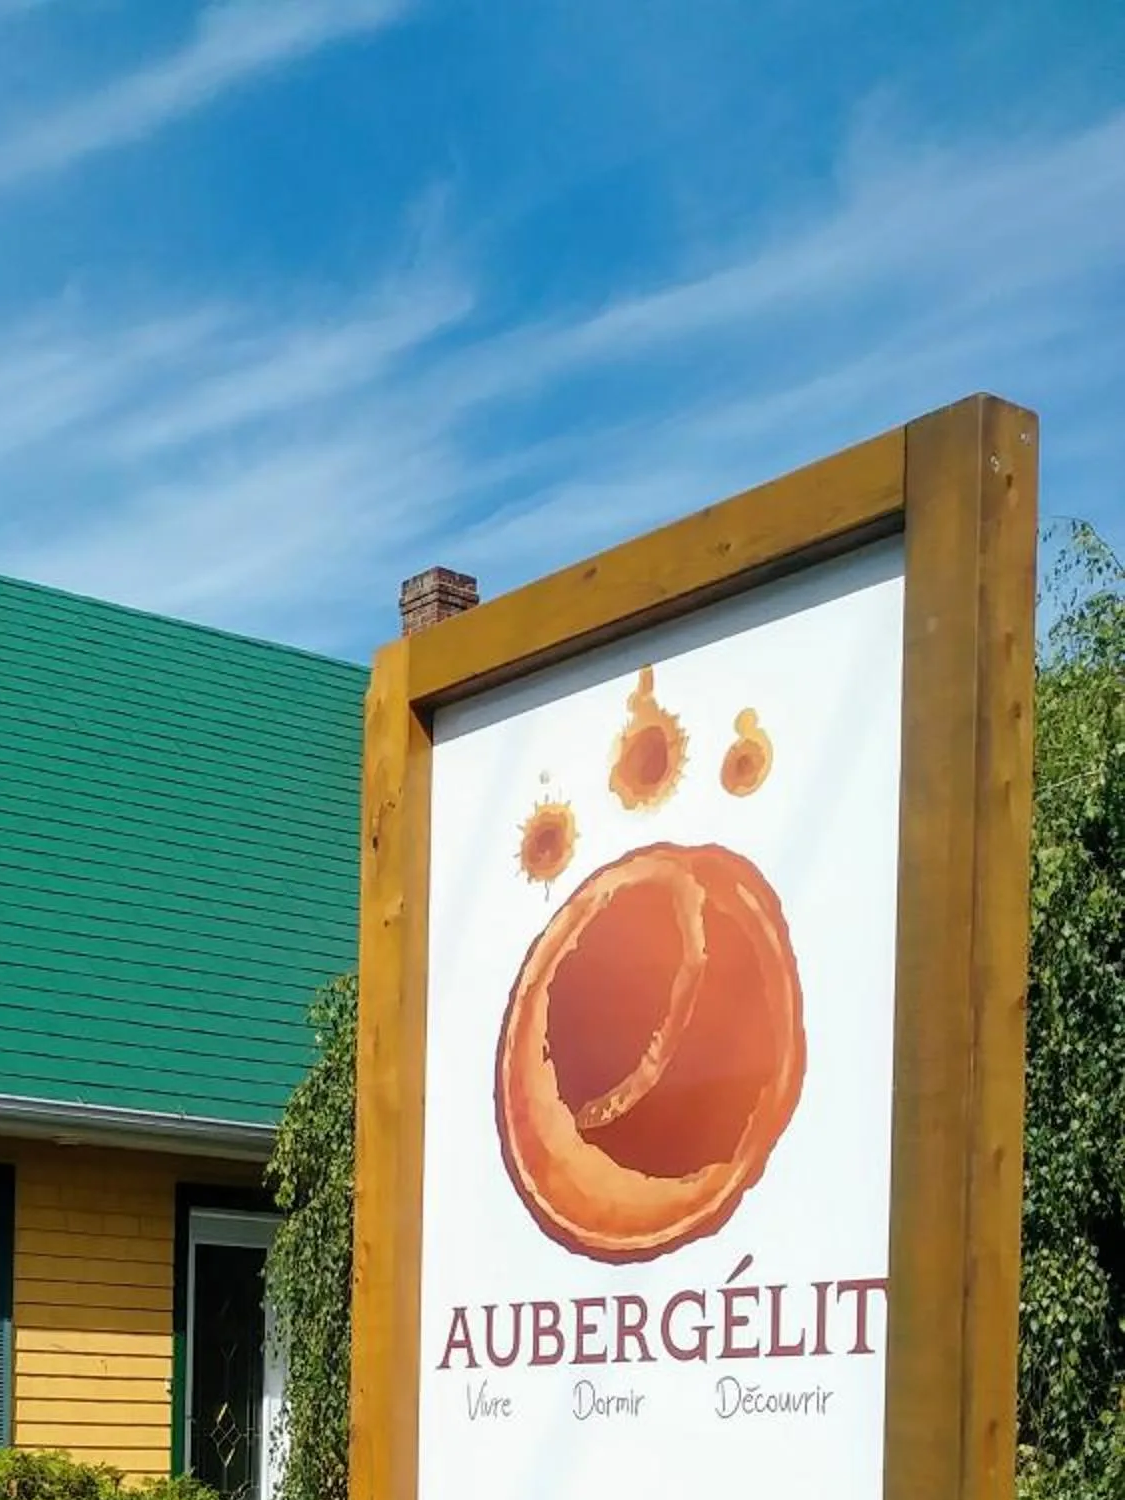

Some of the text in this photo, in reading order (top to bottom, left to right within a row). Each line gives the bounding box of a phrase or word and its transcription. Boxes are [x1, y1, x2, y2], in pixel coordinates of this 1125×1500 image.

[436, 1254, 889, 1369] AUBERGÉLIT
[466, 1375, 834, 1421] Vivre Dormir Découvrir
